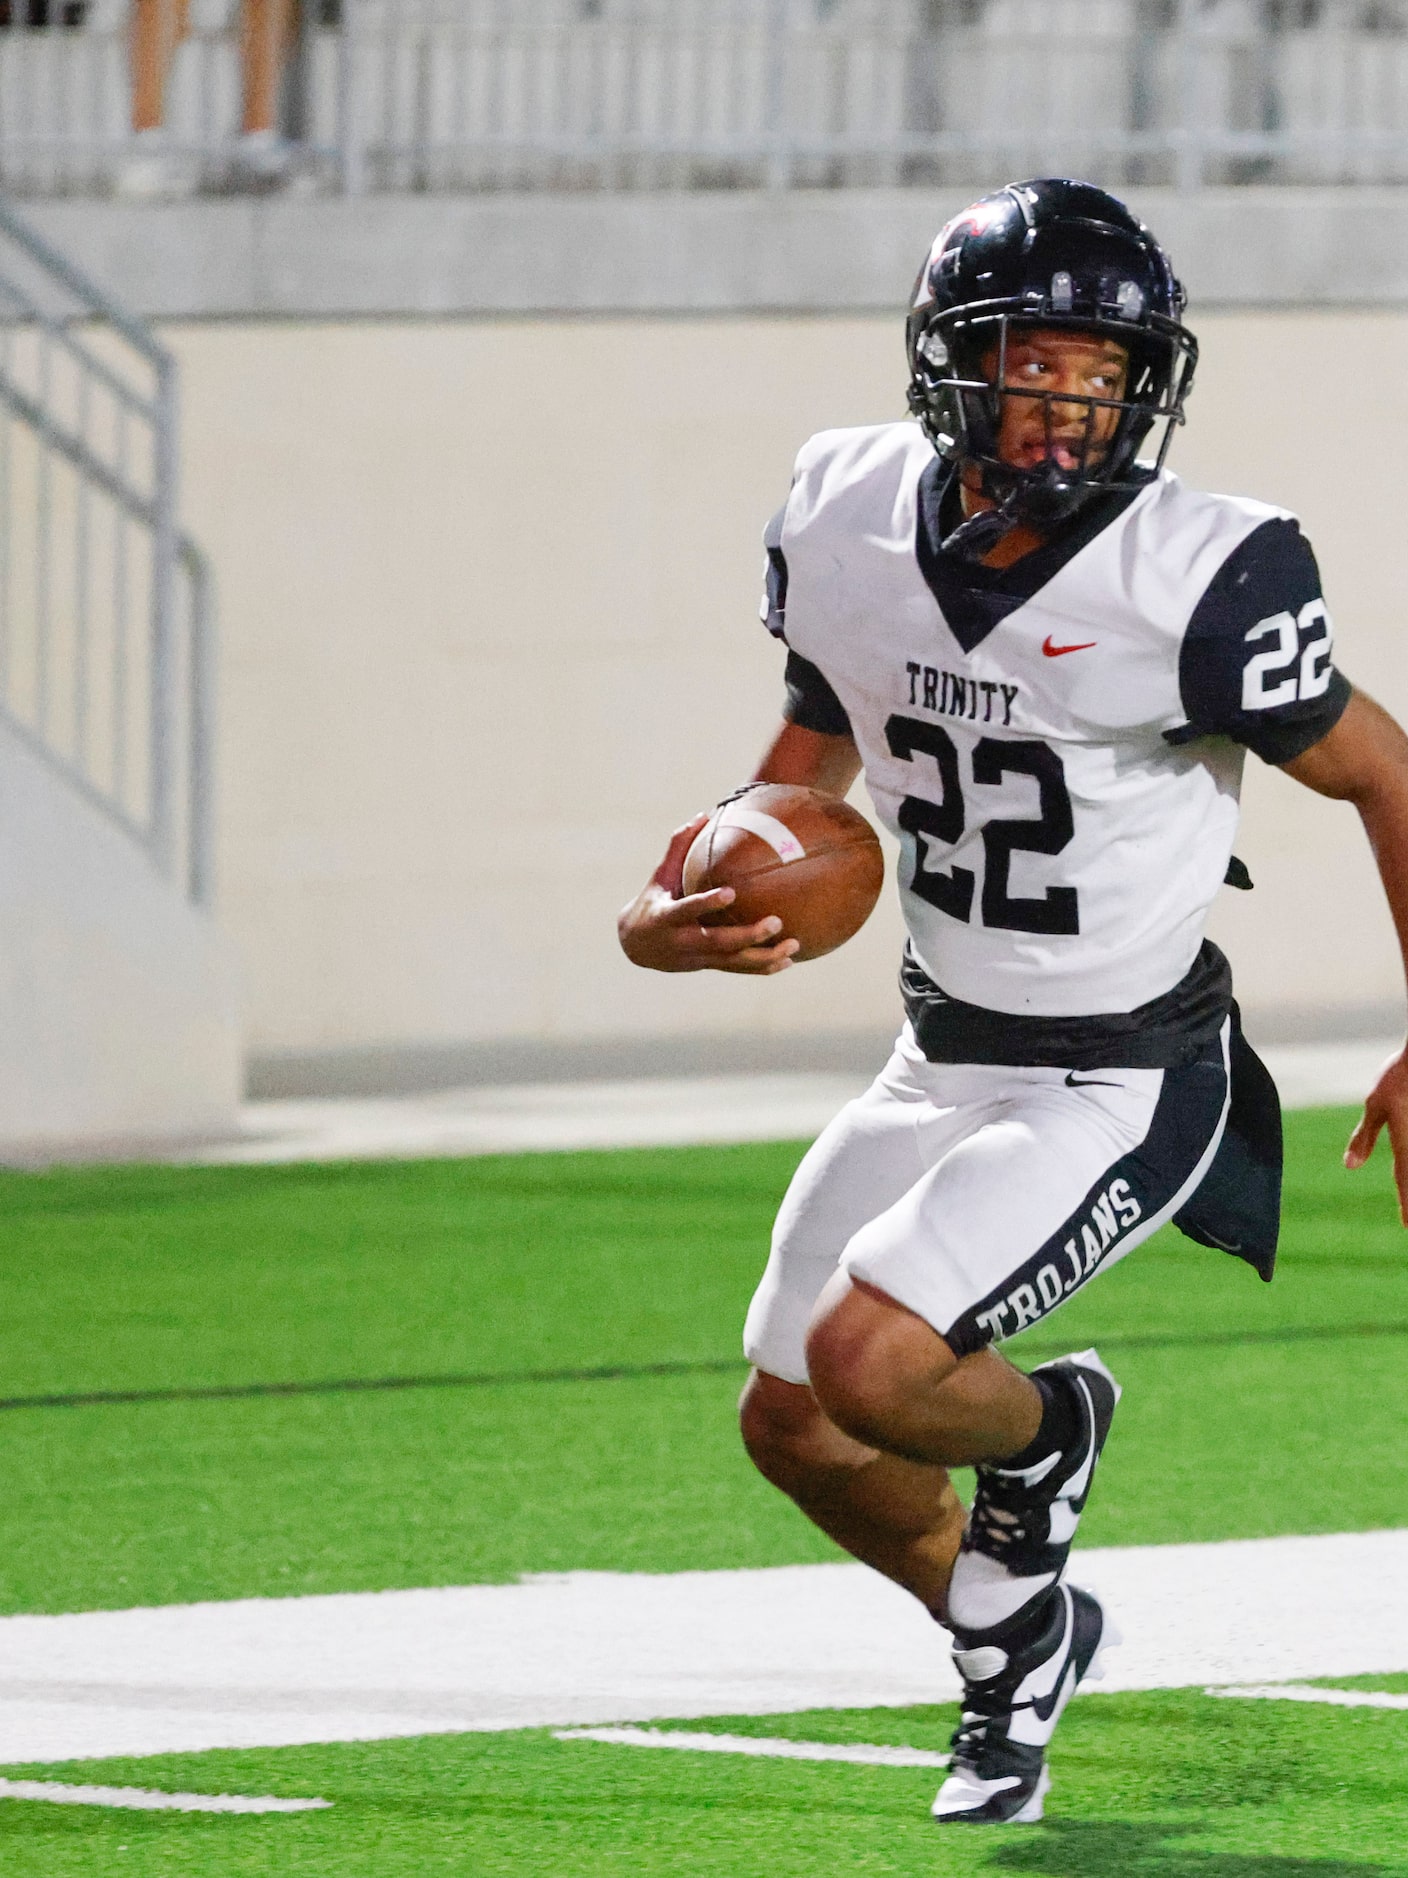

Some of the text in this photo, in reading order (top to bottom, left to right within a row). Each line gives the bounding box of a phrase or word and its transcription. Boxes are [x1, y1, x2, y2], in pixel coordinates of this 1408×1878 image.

[906, 661, 1018, 726] TRINITY
[1241, 597, 1334, 711] 22
[884, 713, 1080, 935] 22
[975, 1178, 1142, 1341] TROJANS
